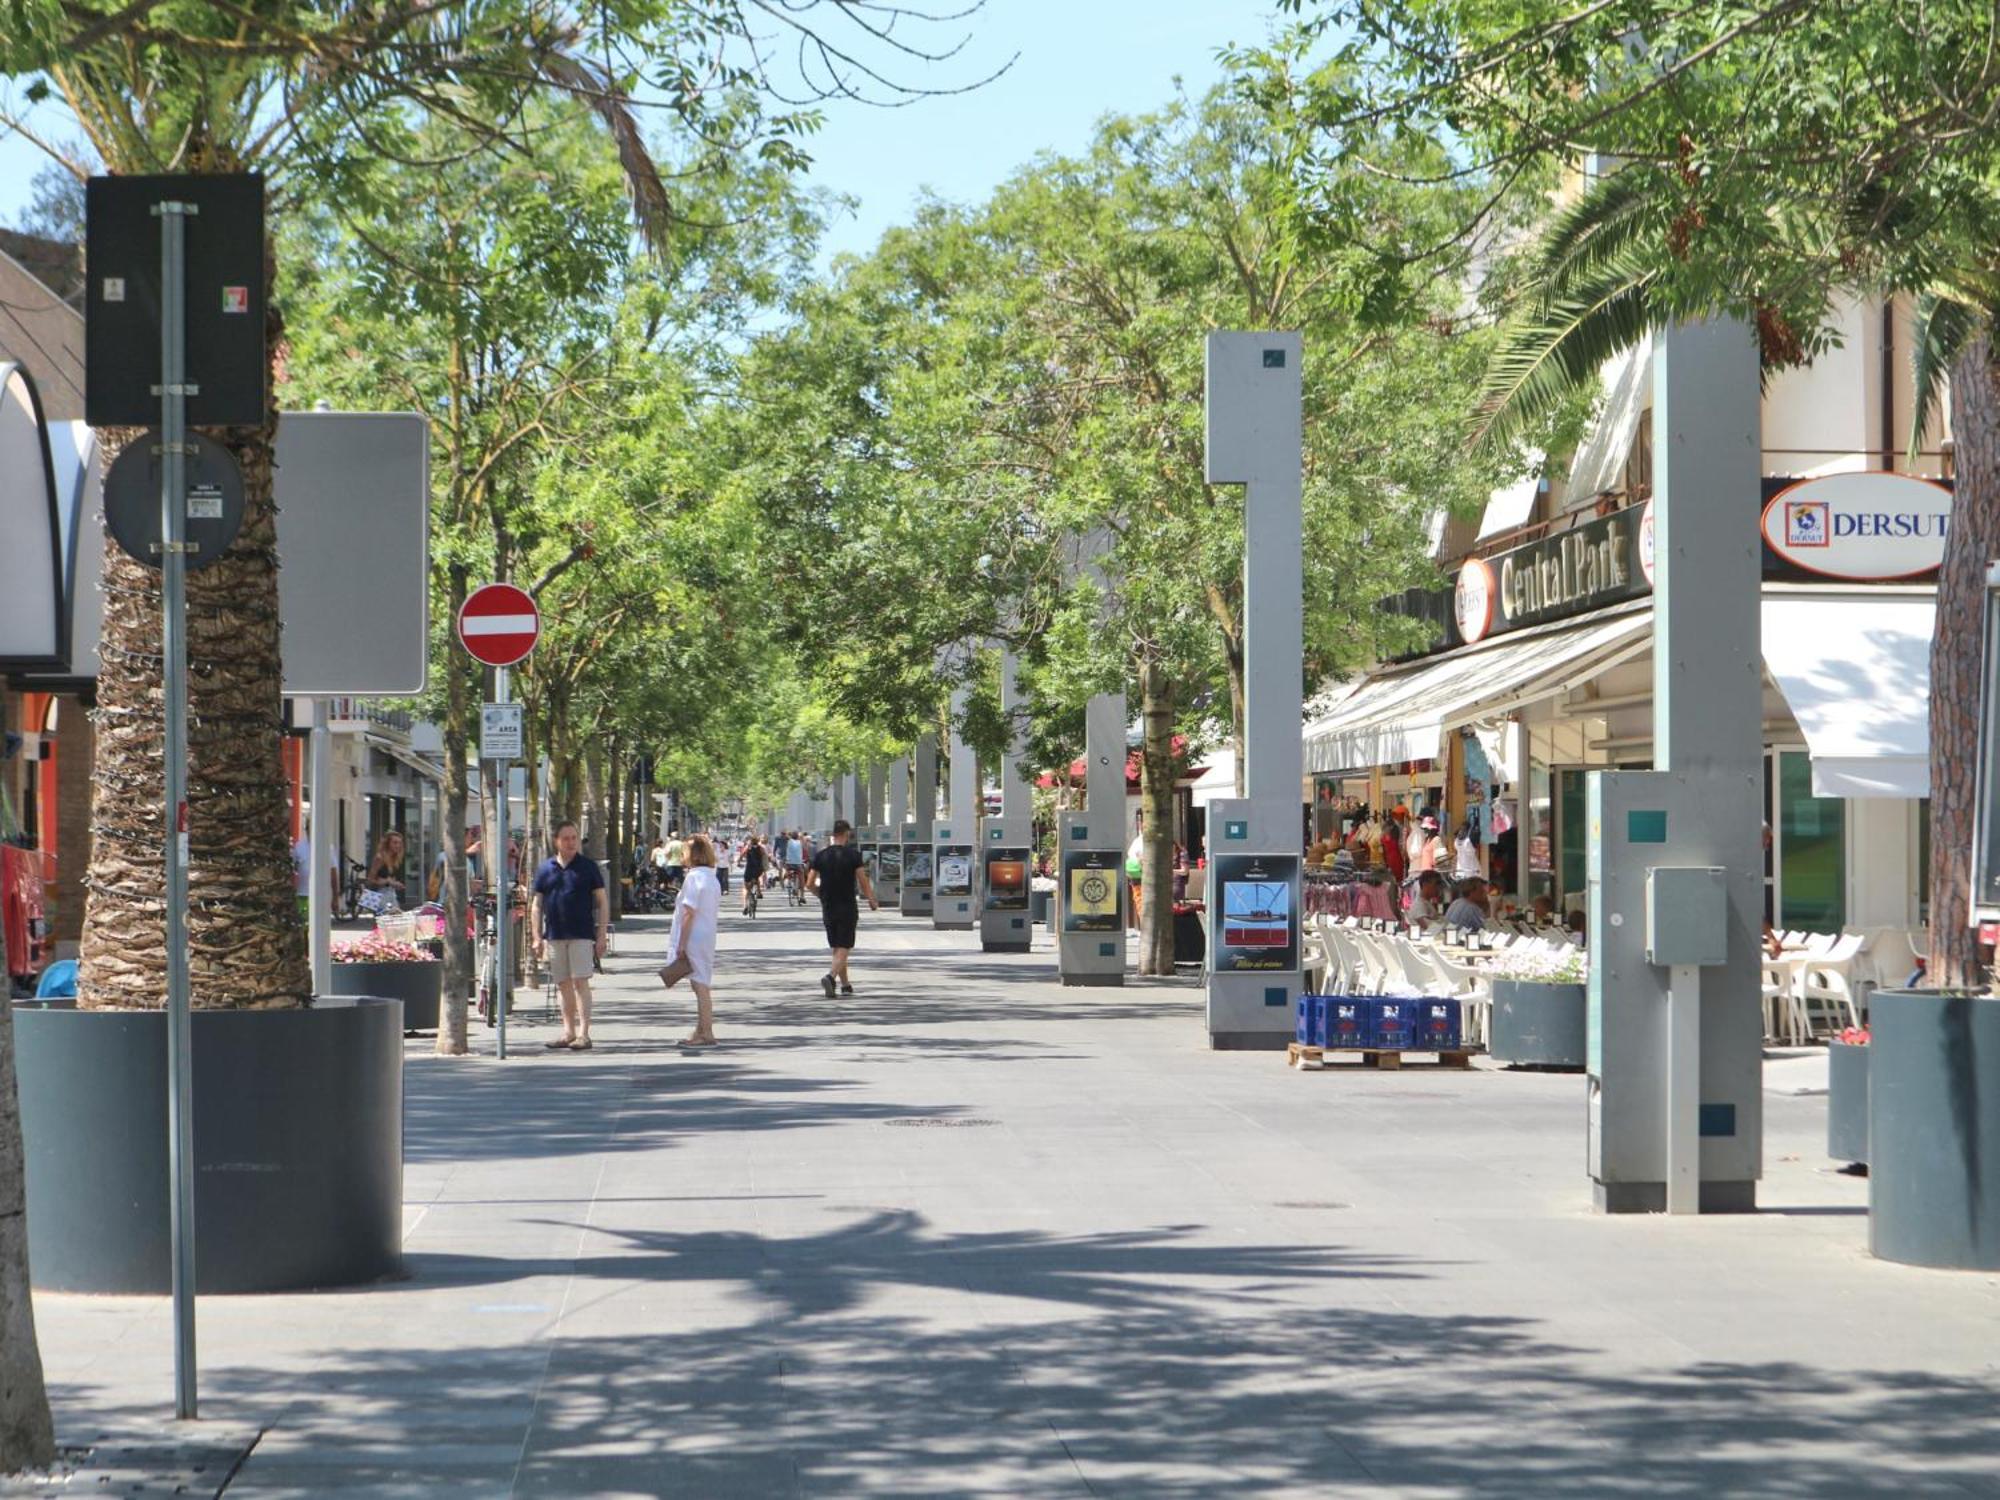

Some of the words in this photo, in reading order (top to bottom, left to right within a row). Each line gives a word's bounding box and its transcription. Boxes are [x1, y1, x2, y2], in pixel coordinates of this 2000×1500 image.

[1834, 513, 1949, 537] DERSUT
[1502, 537, 1573, 620] Central
[1575, 519, 1627, 599] Park
